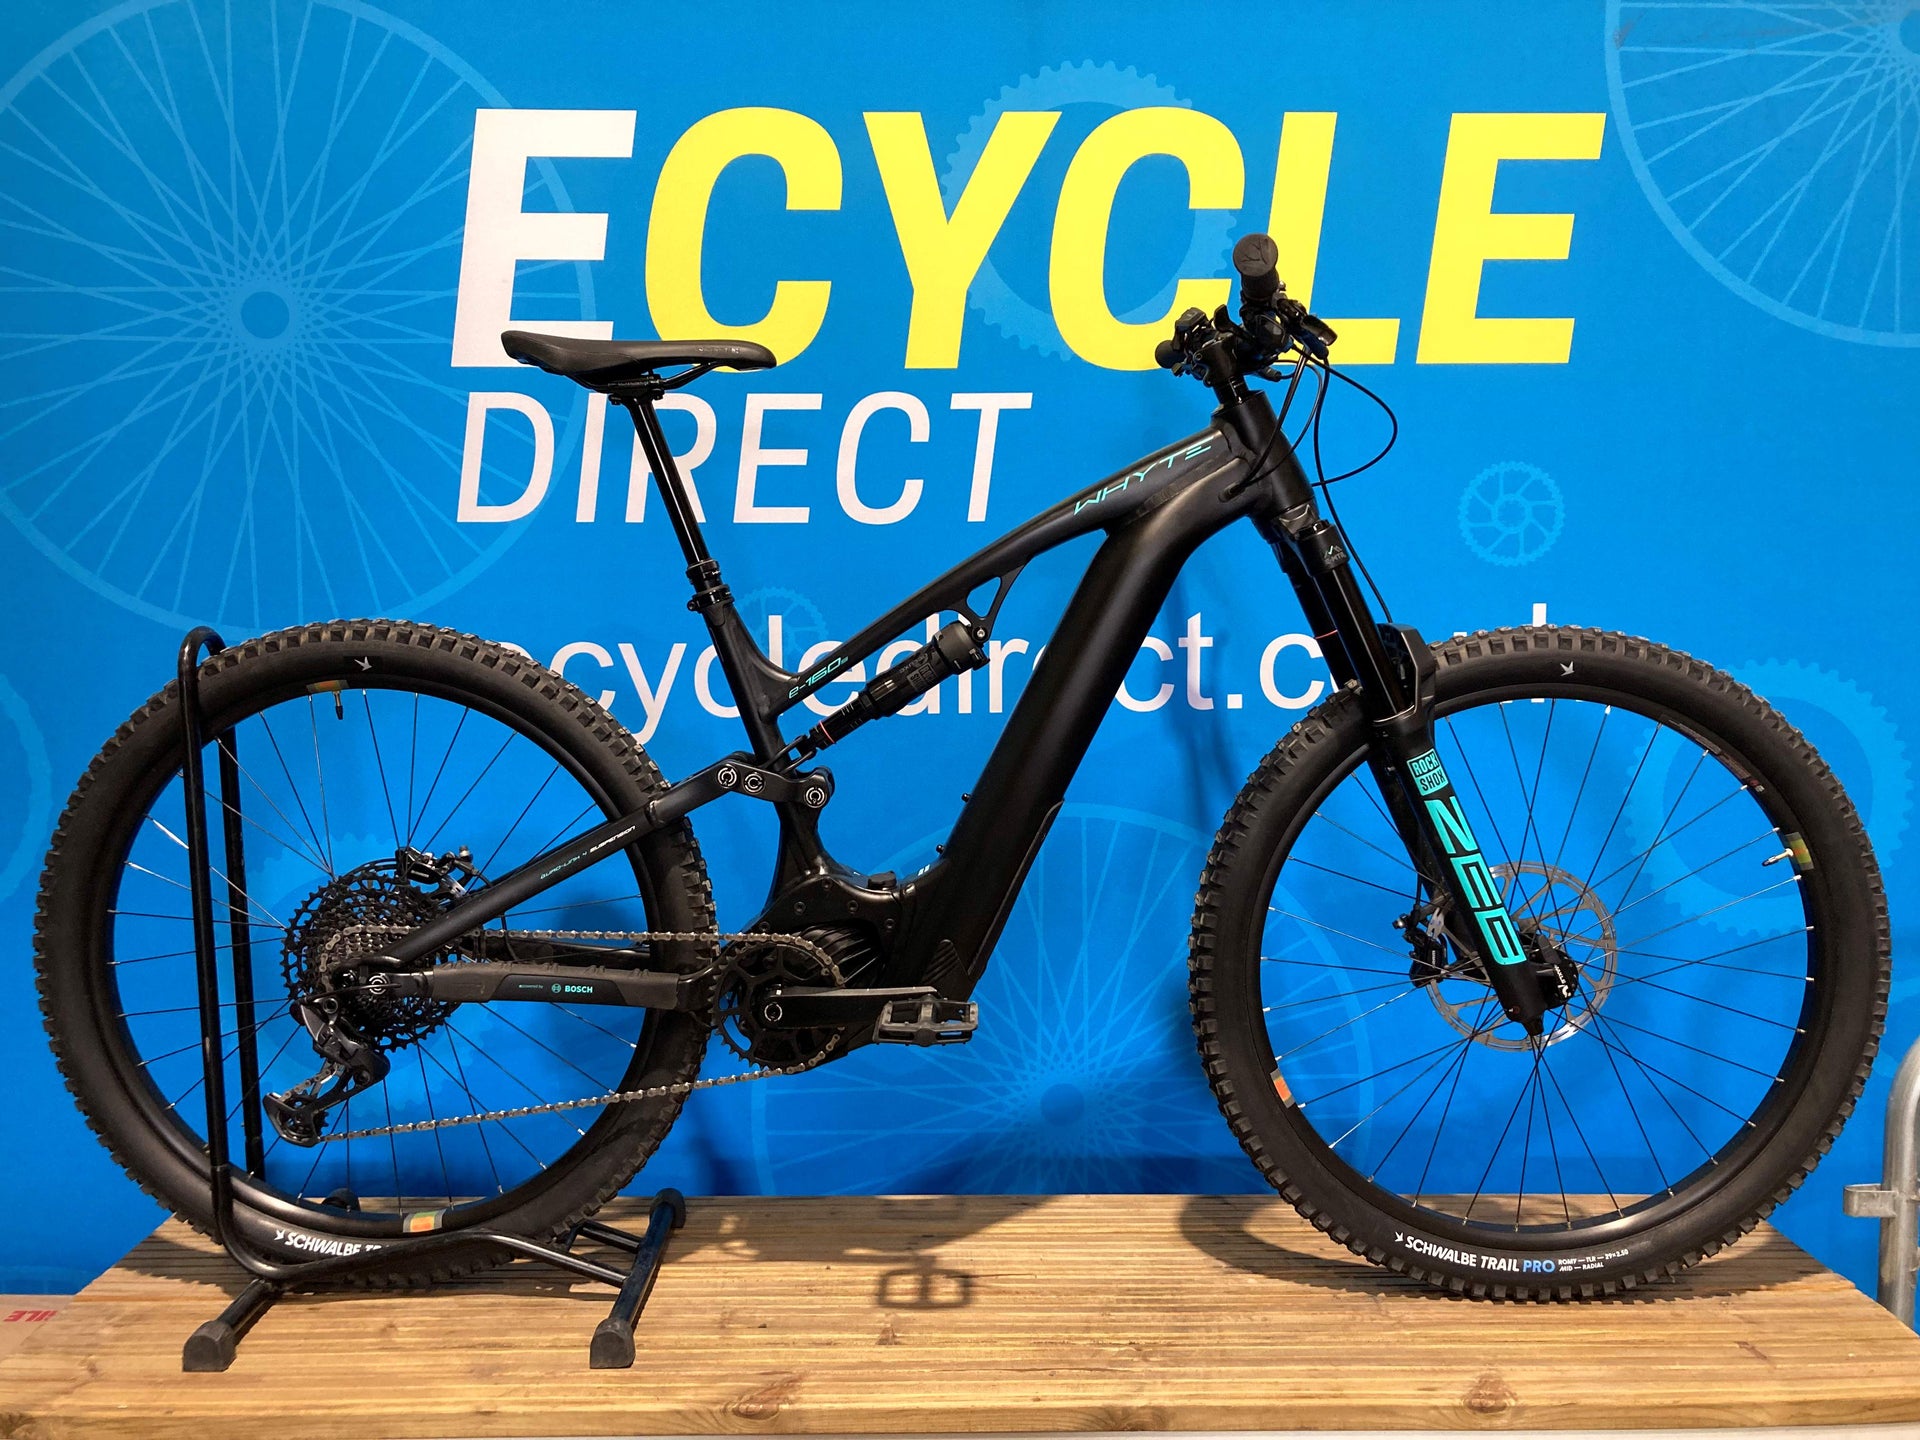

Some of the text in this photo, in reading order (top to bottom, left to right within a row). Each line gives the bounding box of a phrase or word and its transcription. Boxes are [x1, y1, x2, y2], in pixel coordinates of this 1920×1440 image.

[451, 106, 1606, 371] ECYCLE
[456, 391, 1032, 524] DIRECT
[1074, 436, 1214, 515] WHYTE
[1412, 753, 1438, 776] ROCK
[1420, 769, 1445, 791] SHOX
[1424, 796, 1527, 966] ZEB
[565, 985, 593, 993] BOSCH
[285, 1231, 361, 1256] SCHWALBE
[1405, 1236, 1556, 1273] SCHWALBE TRAIL PRO
[1582, 1262, 1604, 1270] RADIAL
